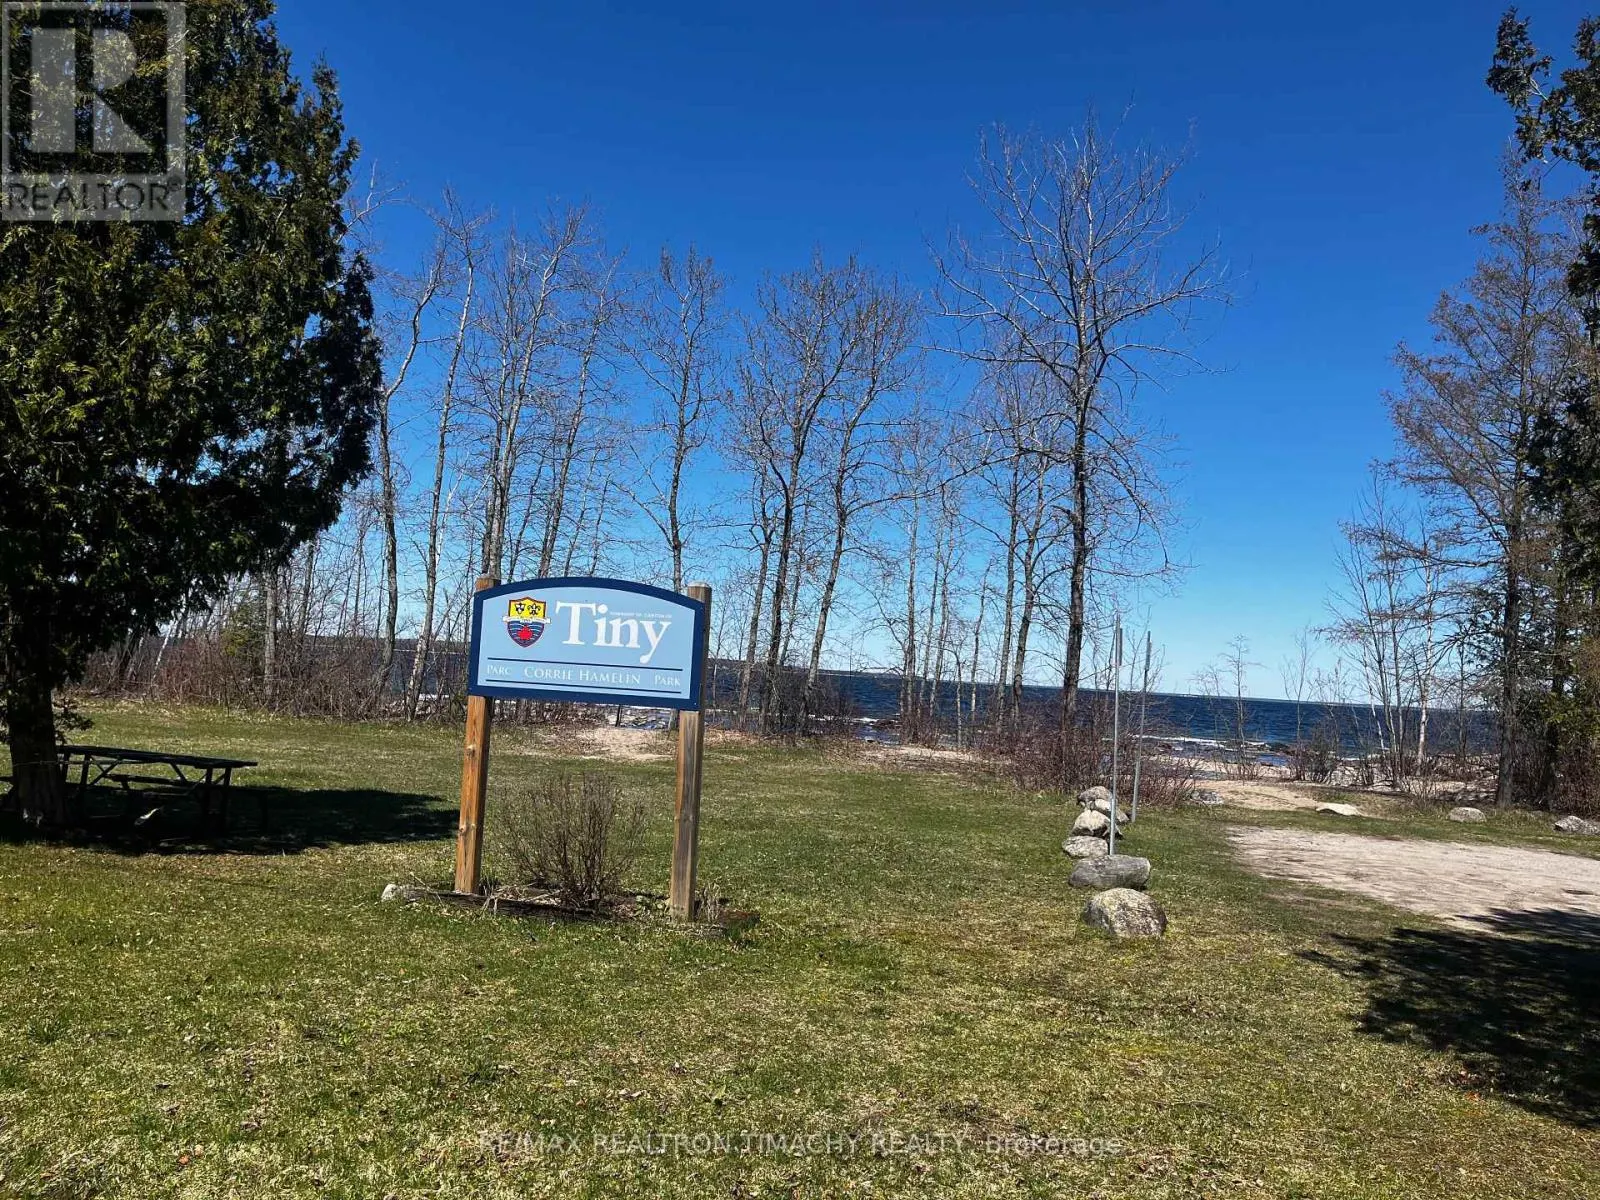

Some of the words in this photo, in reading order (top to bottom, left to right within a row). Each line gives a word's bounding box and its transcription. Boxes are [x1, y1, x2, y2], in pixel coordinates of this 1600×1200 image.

[555, 601, 672, 664] Tiny
[523, 666, 573, 681] CORRIE
[579, 670, 641, 685] HAMELIN
[654, 674, 681, 687] PARK
